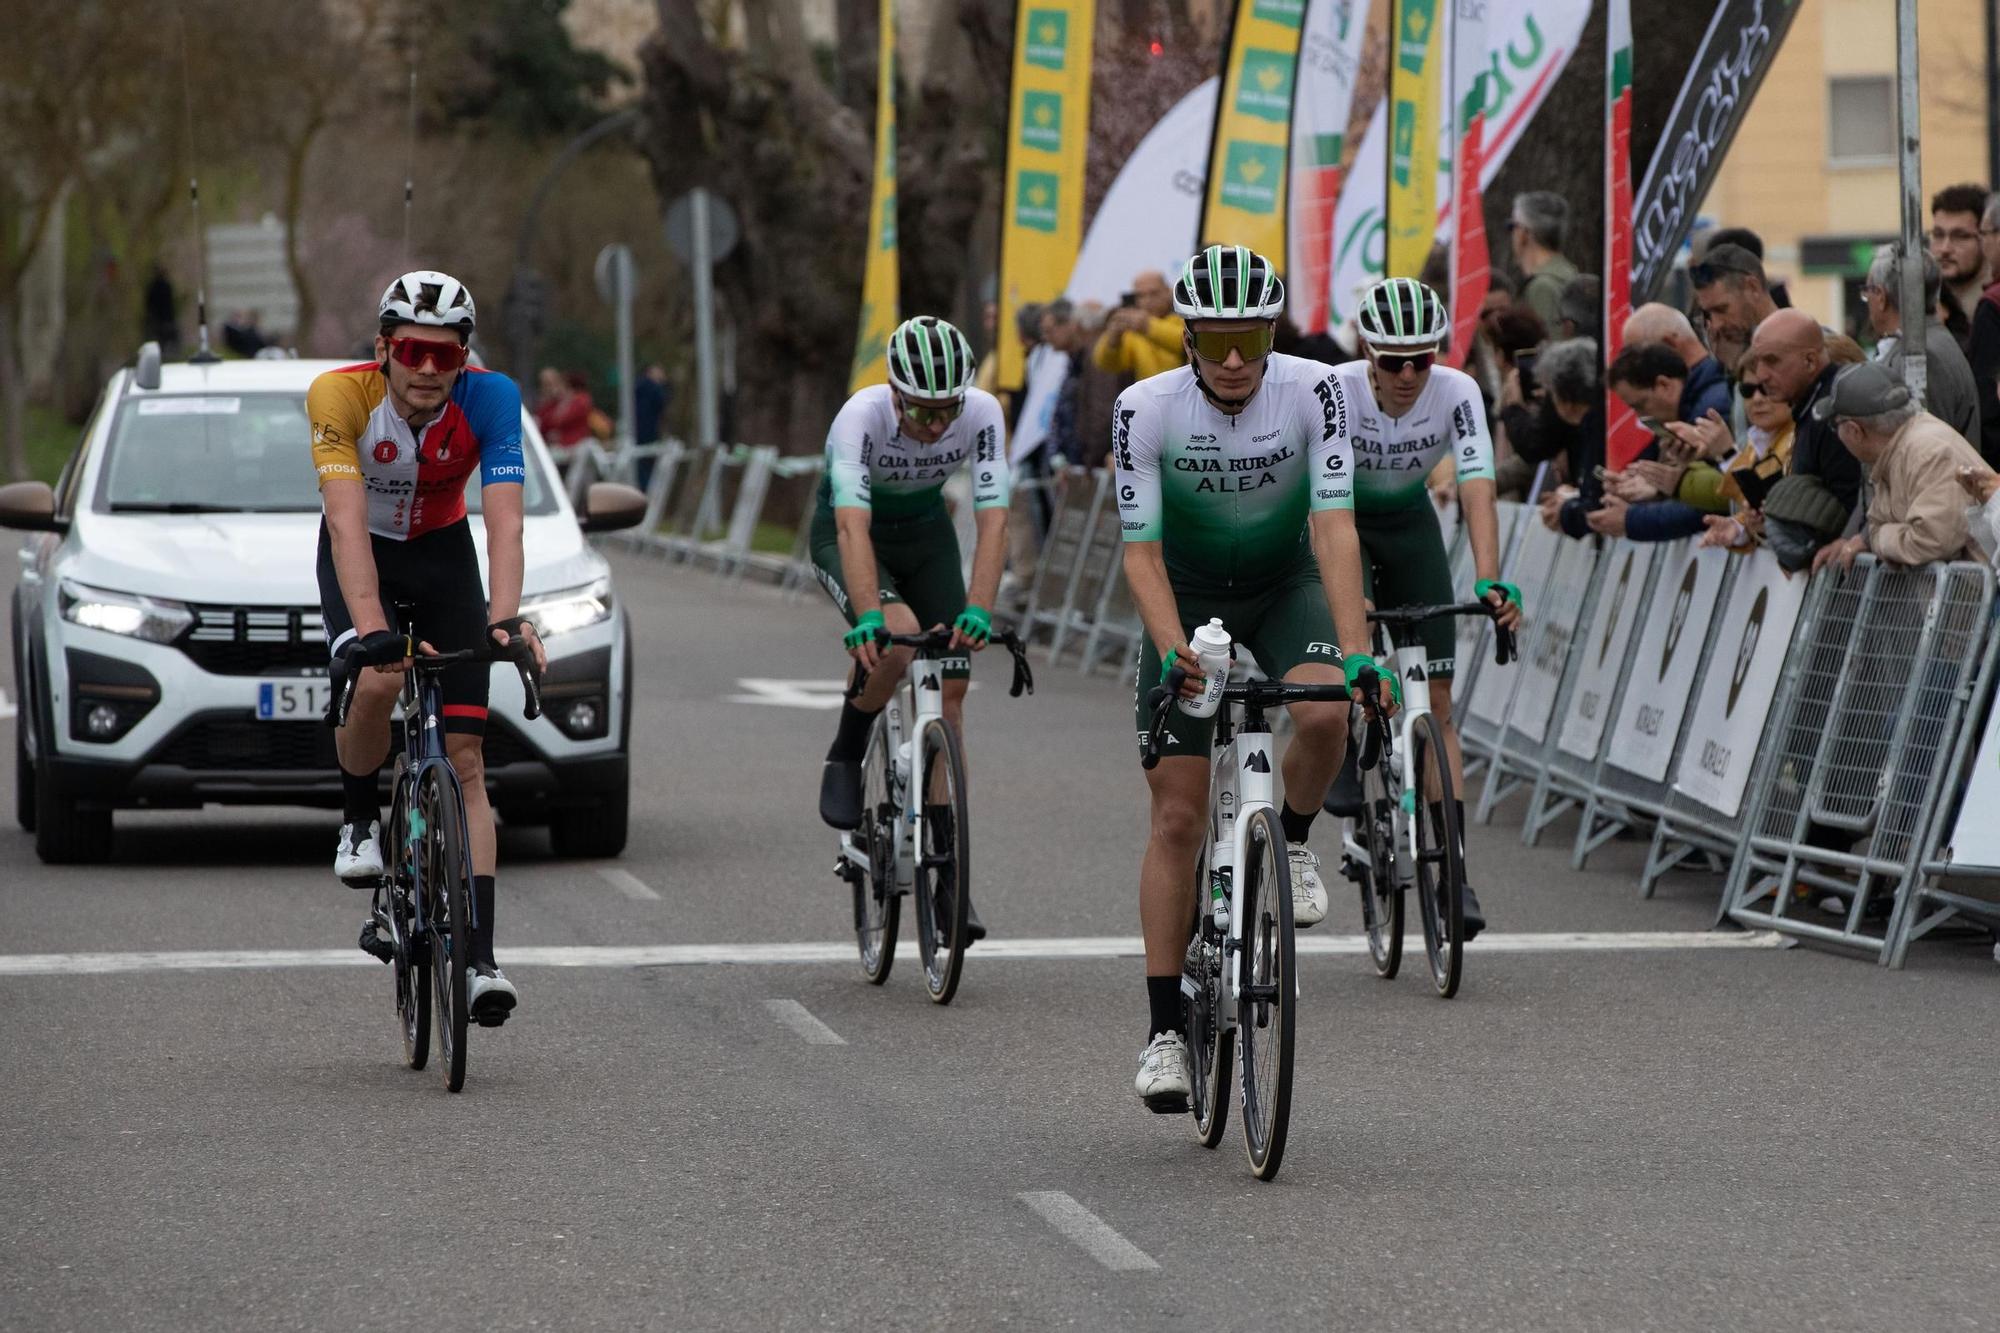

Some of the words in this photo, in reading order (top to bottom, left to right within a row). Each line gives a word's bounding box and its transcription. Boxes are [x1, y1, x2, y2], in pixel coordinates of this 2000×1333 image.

[1313, 379, 1337, 442] RGA
[1327, 373, 1347, 439] SEGUROS
[1112, 399, 1122, 469] SEGUROS
[1118, 409, 1136, 472] RGA
[1350, 435, 1383, 455] CAJA
[1387, 433, 1441, 454] RURAL
[914, 448, 966, 467] RURAL
[1174, 457, 1223, 472] CAJA
[1228, 446, 1295, 472] RURAL
[1326, 454, 1343, 471] G
[1355, 456, 1422, 471] ALEA
[318, 463, 357, 474] RTOSA
[884, 468, 946, 482] ALEA
[1121, 485, 1135, 501] G
[1195, 472, 1277, 493] ALEA
